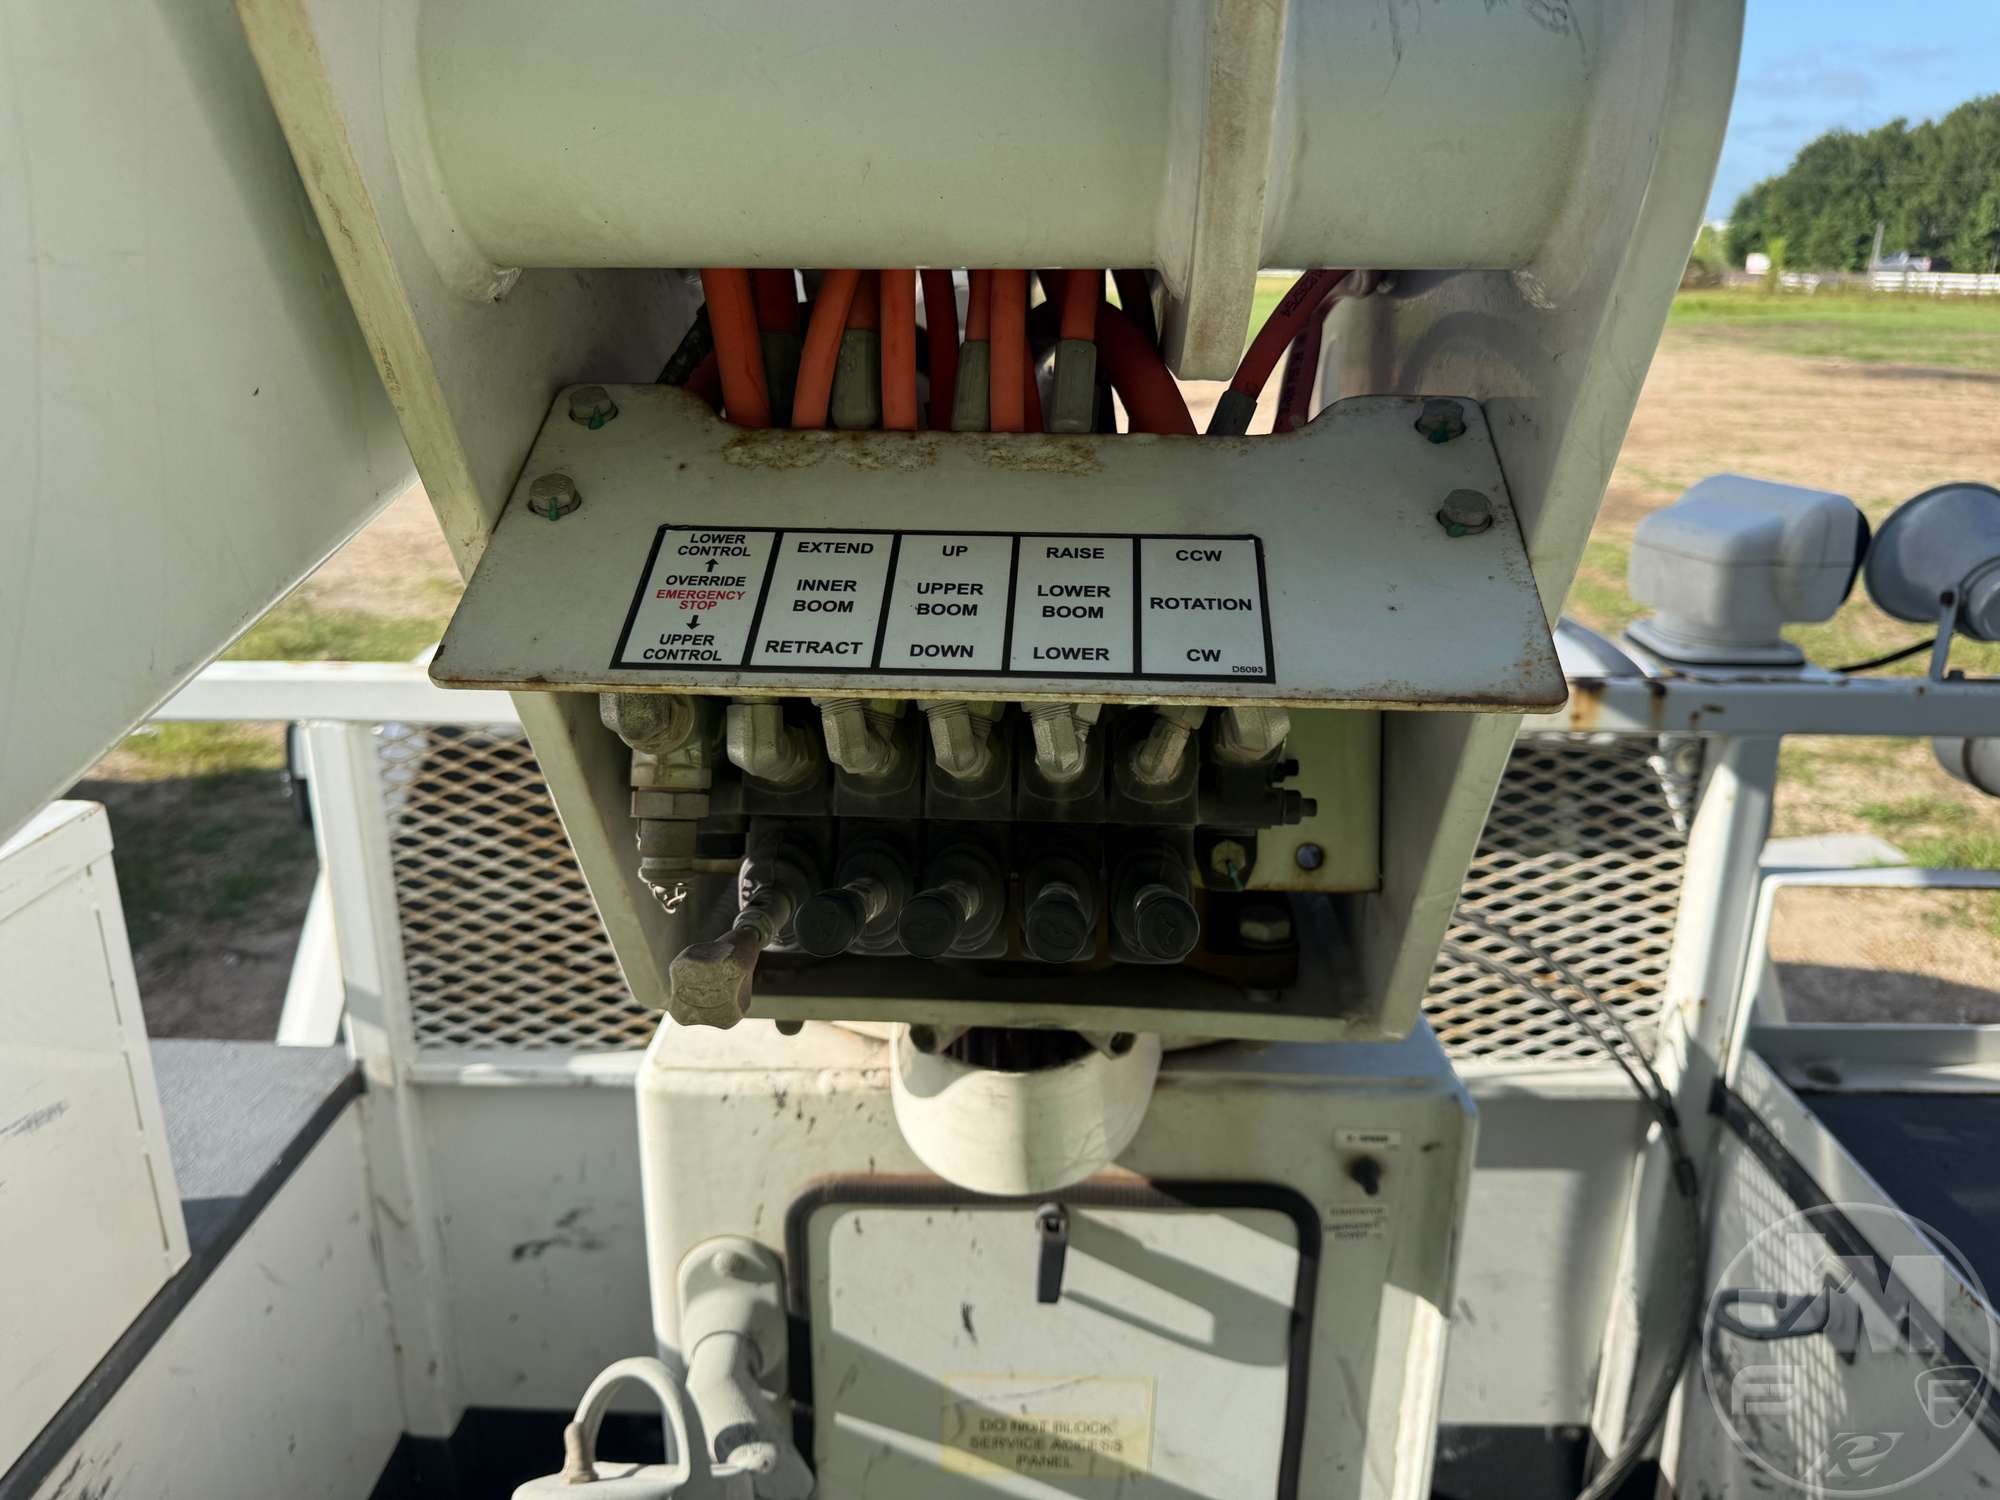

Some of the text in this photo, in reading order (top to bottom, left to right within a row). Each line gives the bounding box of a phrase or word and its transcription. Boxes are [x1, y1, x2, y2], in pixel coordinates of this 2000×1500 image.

[690, 533, 746, 545] LOWER
[678, 545, 751, 557] CONTROL
[797, 541, 873, 554] EXTEND
[942, 545, 968, 557] UP
[1046, 547, 1104, 559] RAISE
[1176, 550, 1222, 561] CCW
[666, 575, 746, 587] OVERRIDE
[797, 579, 857, 592] INNER
[656, 590, 746, 600] EMERGENCY
[917, 583, 983, 595] UPPER
[1038, 585, 1111, 597] LOWER
[679, 600, 717, 610] STOP
[793, 600, 854, 612] BOOM
[916, 603, 977, 616] BOOM
[1150, 597, 1252, 610] ROTATION
[1042, 606, 1104, 619] BOOM
[659, 634, 714, 646] UPPER
[765, 640, 863, 655] RETRACT
[910, 644, 973, 658] DOWN
[1033, 647, 1109, 660] LOWER
[643, 649, 722, 661] CONTROL
[1187, 649, 1221, 662] CW
[980, 1419, 1112, 1433] DO NOT BLOCK
[970, 1437, 1123, 1451] SERVICE ACCESS
[1016, 1456, 1071, 1468] PANEL
